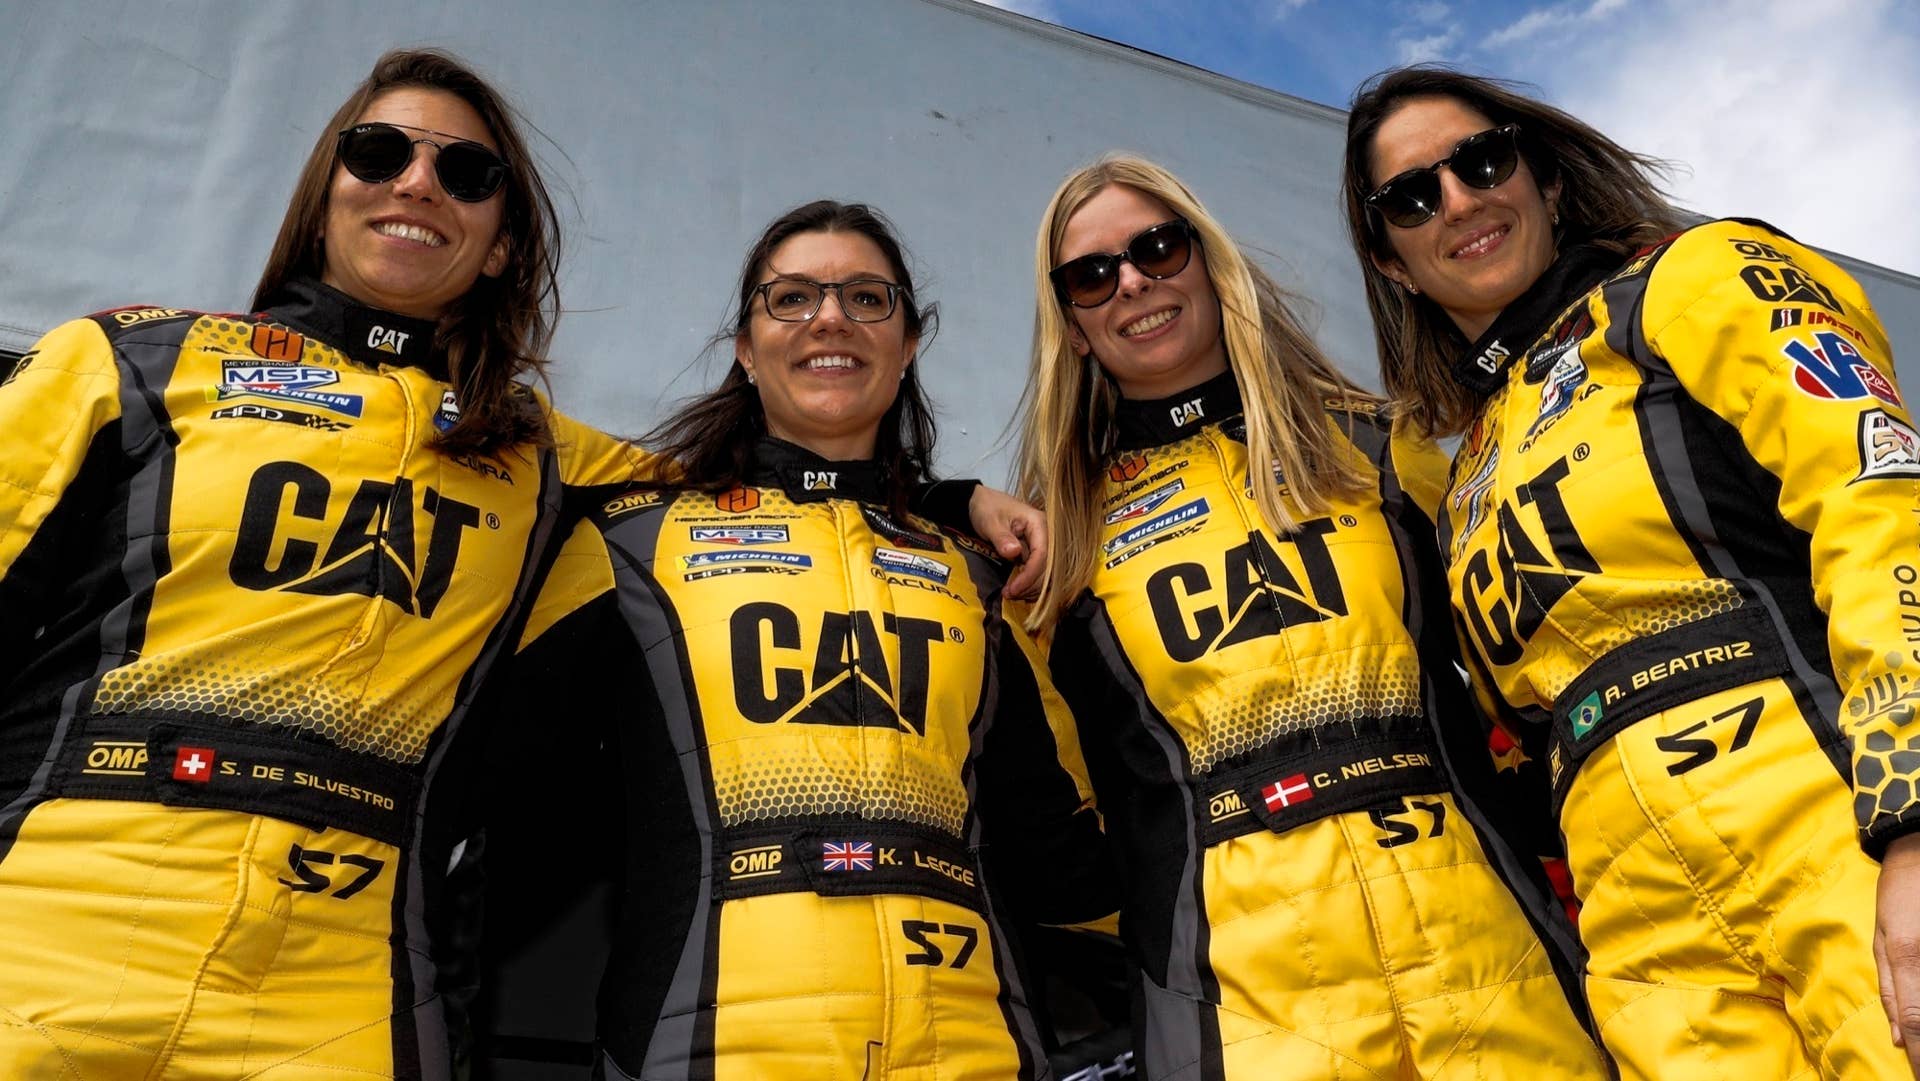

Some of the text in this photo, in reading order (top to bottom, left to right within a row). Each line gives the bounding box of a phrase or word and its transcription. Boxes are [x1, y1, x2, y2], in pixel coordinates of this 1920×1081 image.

[1739, 264, 1845, 316] CAT
[367, 325, 410, 355] CAT
[1807, 311, 1871, 350] IMSA
[224, 360, 259, 368] MEYER
[1476, 339, 1511, 375] CAT
[228, 368, 333, 383] MSR
[215, 405, 284, 421] HPD
[251, 385, 351, 406] MICHELIN
[1169, 398, 1206, 428] CAT
[803, 471, 839, 491] CAT
[602, 490, 661, 514] OMP
[229, 460, 482, 619] CAT
[695, 531, 784, 540] MSR
[1127, 505, 1199, 542] MICHELIN
[714, 553, 800, 563] MICHELIN
[1462, 455, 1604, 667] CAT
[886, 576, 969, 606] ACURA
[1145, 516, 1350, 664] CAT
[729, 601, 944, 737] CAT
[1604, 640, 1754, 706] A. BEATRIZ
[1655, 695, 1765, 778] 57
[86, 746, 149, 770] OMP
[1312, 753, 1432, 789] C. NIELSEN
[219, 760, 395, 811] S. DE SILVESTRO
[1209, 796, 1248, 818] OM
[1368, 801, 1446, 849] 57
[277, 842, 386, 900] 57
[730, 850, 783, 874] OMP
[878, 847, 976, 888] K. LEGGE
[901, 919, 979, 970] 57
